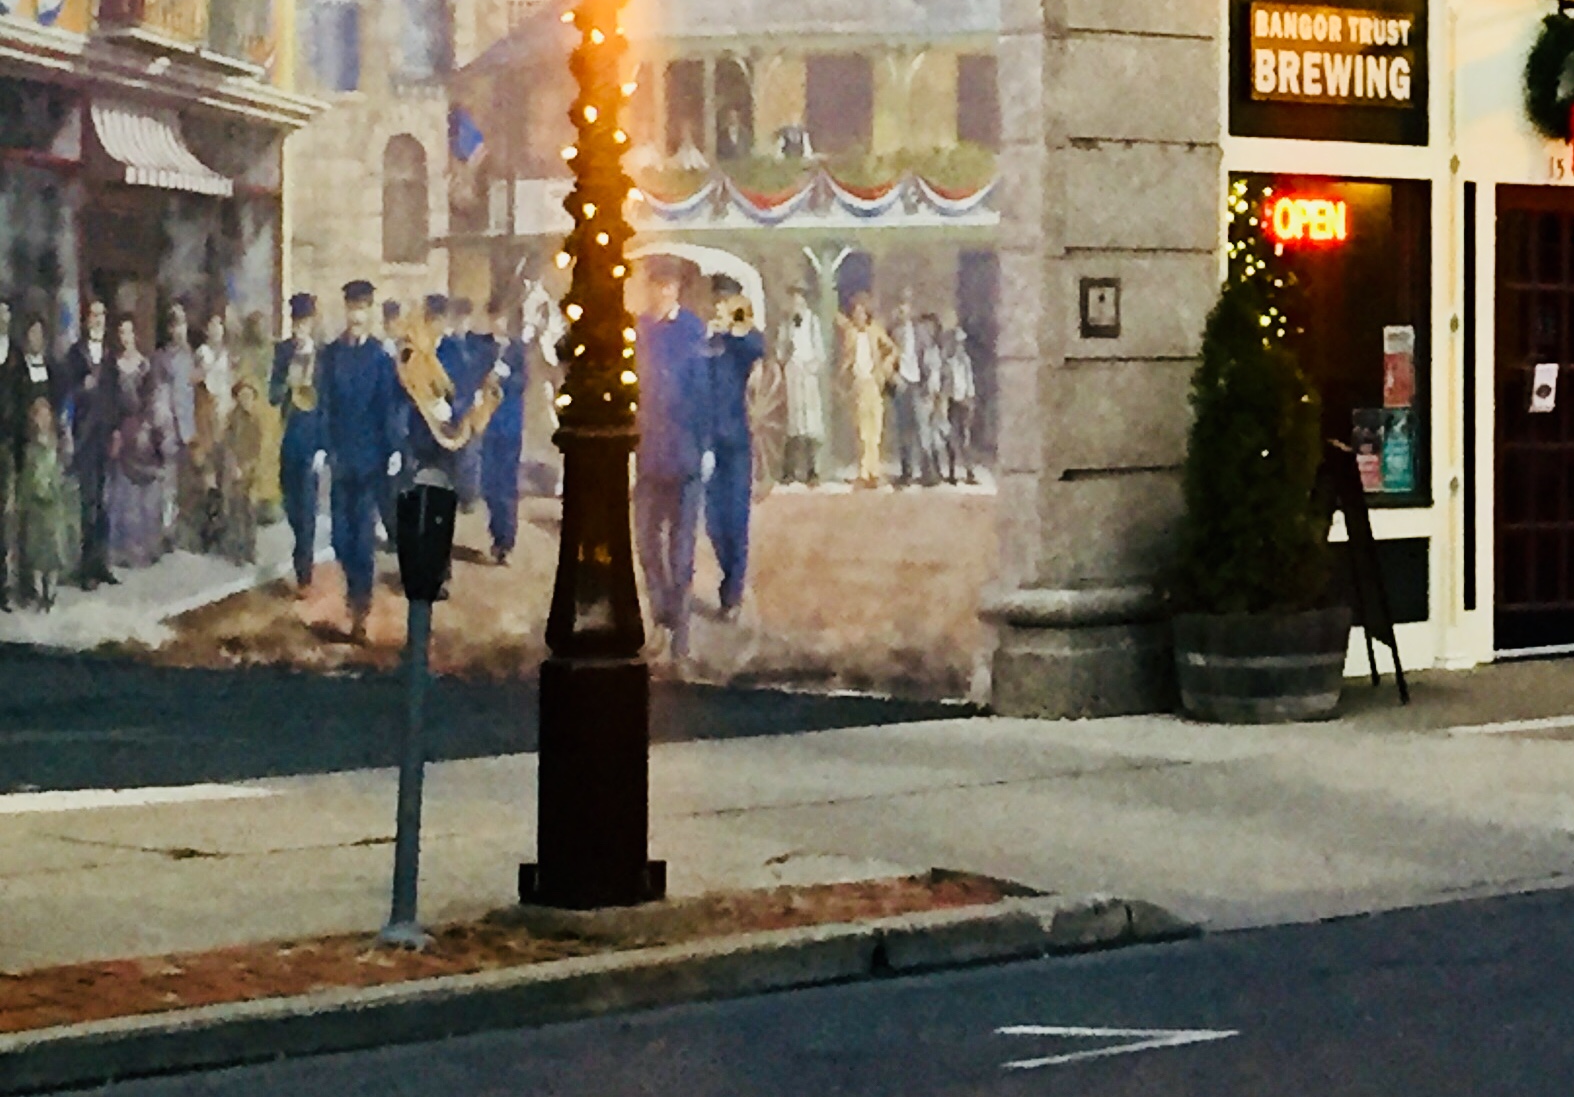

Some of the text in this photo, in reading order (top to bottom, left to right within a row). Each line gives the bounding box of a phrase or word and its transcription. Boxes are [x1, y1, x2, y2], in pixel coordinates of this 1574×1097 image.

[1255, 9, 1411, 46] BANGOR TRUST
[1255, 49, 1411, 100] BREWING
[1273, 197, 1346, 241] OPEN
